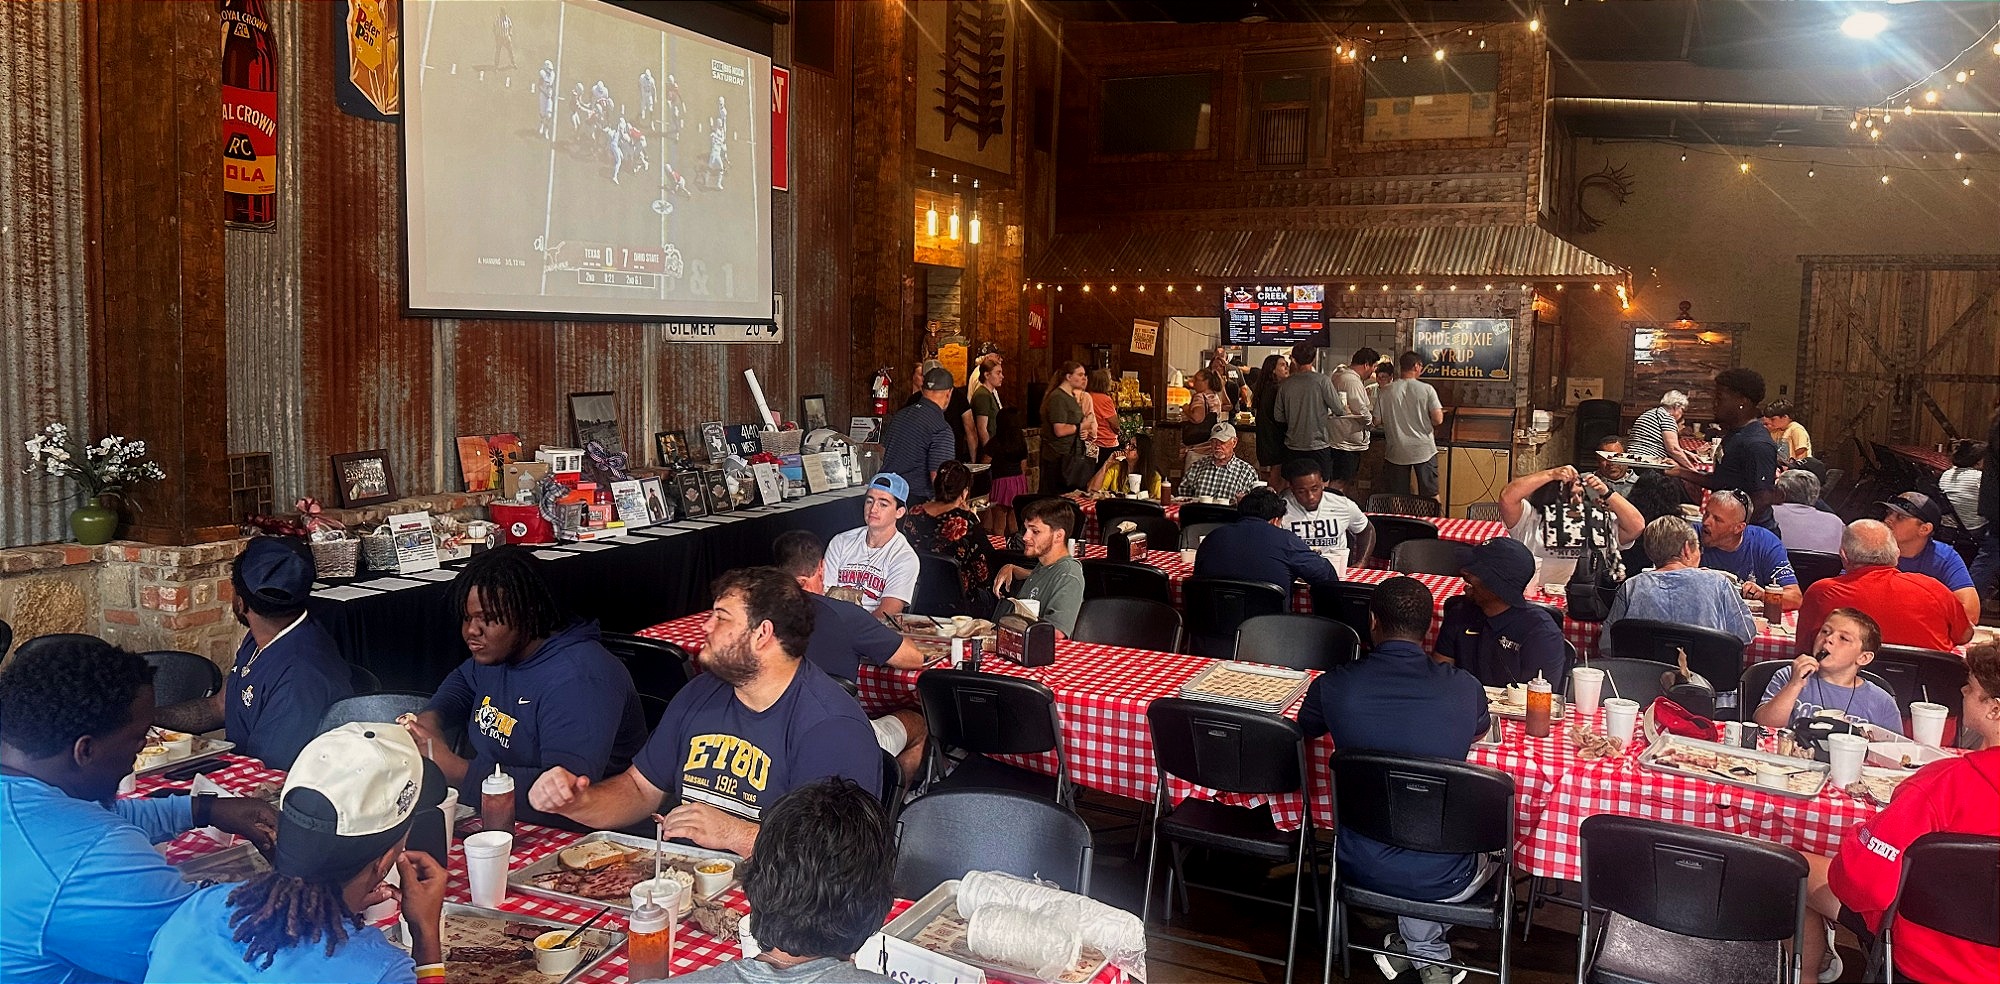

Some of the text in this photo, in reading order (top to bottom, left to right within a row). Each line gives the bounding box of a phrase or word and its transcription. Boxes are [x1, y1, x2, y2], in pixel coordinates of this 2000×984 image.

[221, 10, 268, 32] OYAL CROWN
[356, 7, 380, 38] Peter
[355, 21, 374, 46] Pan
[712, 71, 744, 86] SATURDAY
[236, 104, 276, 137] CROWN
[228, 137, 252, 156] RC
[226, 165, 265, 182] OLA
[585, 247, 659, 268] TEXAS 0 7 OHIO STATE
[1257, 292, 1288, 300] CREEK
[669, 323, 760, 336] GILMER 20
[1441, 321, 1473, 329] EAT
[1418, 331, 1451, 346] PRIDE
[1461, 332, 1493, 346] DIXIE
[1432, 348, 1474, 363] SYRUP
[1420, 363, 1484, 378] for Health
[741, 441, 757, 454] WEST
[1291, 518, 1339, 539] ETBU
[683, 734, 772, 791] ETBU
[684, 773, 757, 803] MARSHALL 1912 TEXAS
[1867, 836, 1900, 862] STATE
